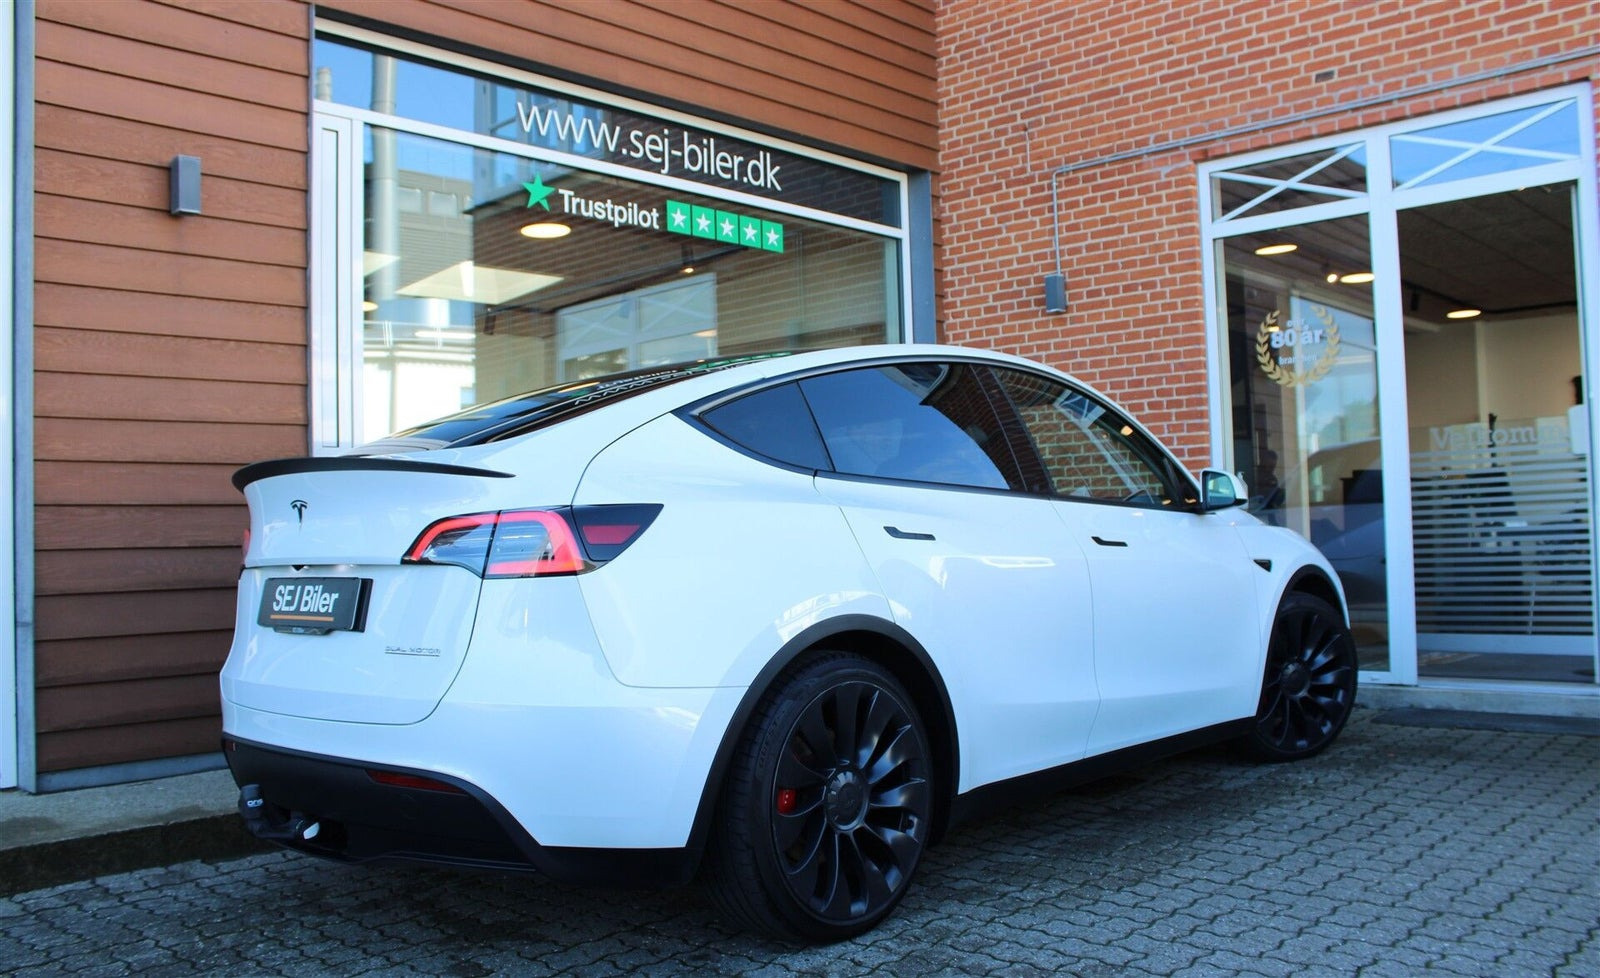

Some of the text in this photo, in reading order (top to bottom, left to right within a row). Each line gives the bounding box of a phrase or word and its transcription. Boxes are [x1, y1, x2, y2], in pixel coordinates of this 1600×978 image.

[517, 101, 783, 192] www.sej-biler.dk
[558, 188, 661, 231] Trustpilot
[1270, 324, 1323, 349] 80 år
[272, 584, 340, 613] SEJ Biler
